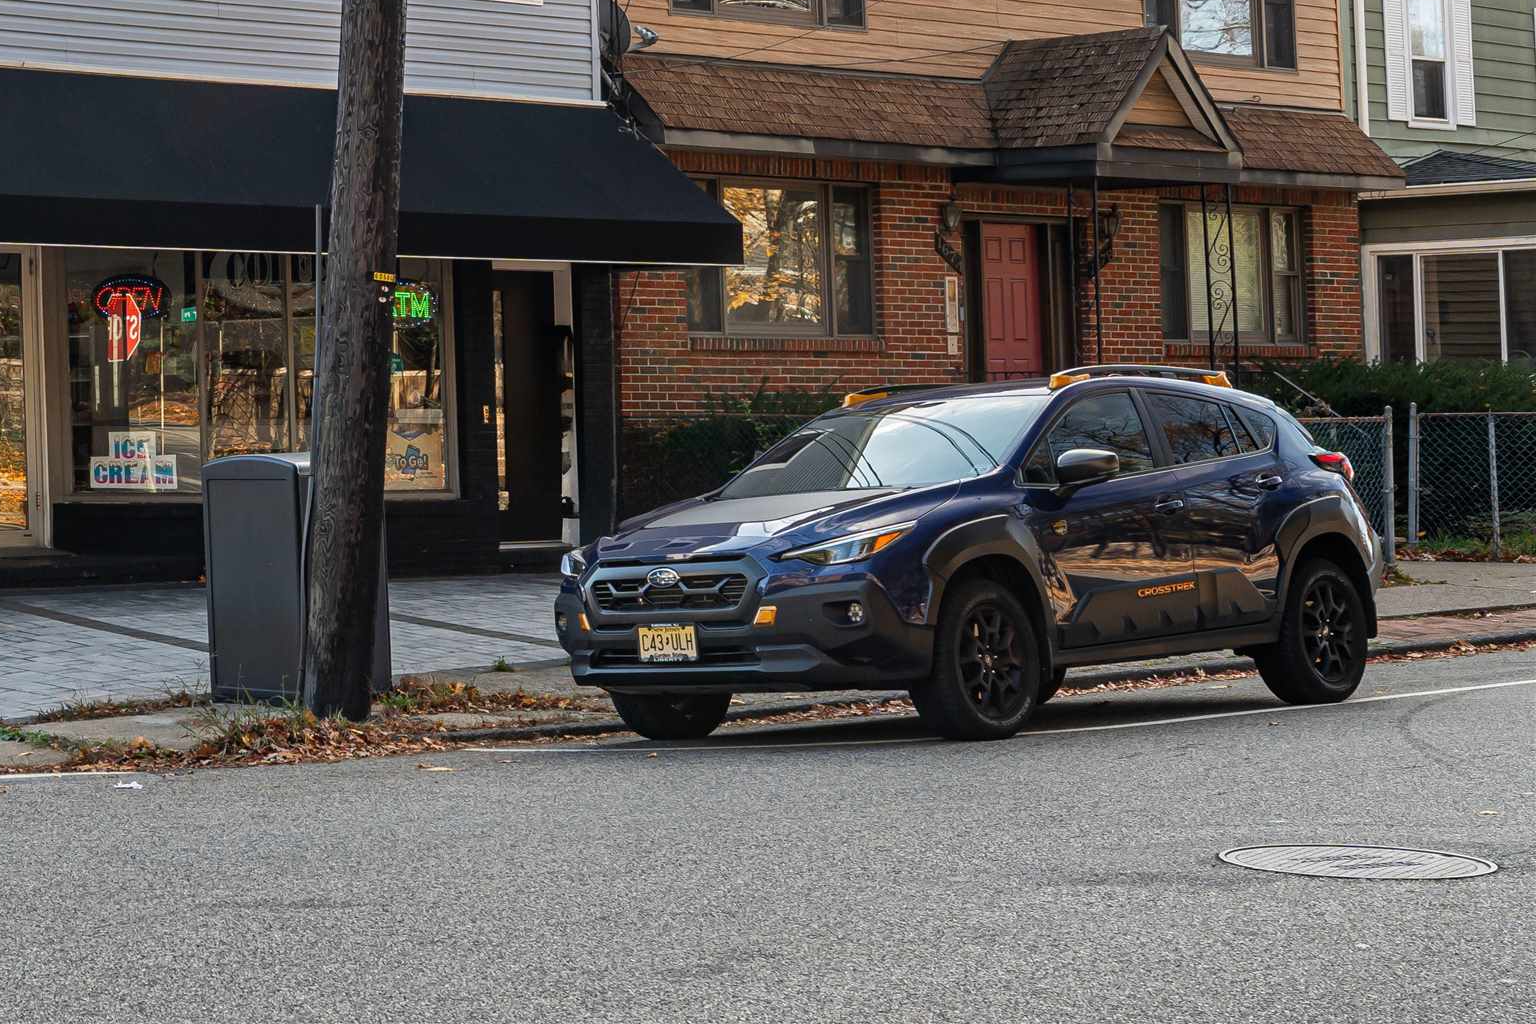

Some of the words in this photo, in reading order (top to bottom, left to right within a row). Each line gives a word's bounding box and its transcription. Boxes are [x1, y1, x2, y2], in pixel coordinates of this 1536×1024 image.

[113, 439, 151, 459] ICE
[94, 462, 174, 484] CREAM
[1137, 581, 1196, 598] CROSSTREK
